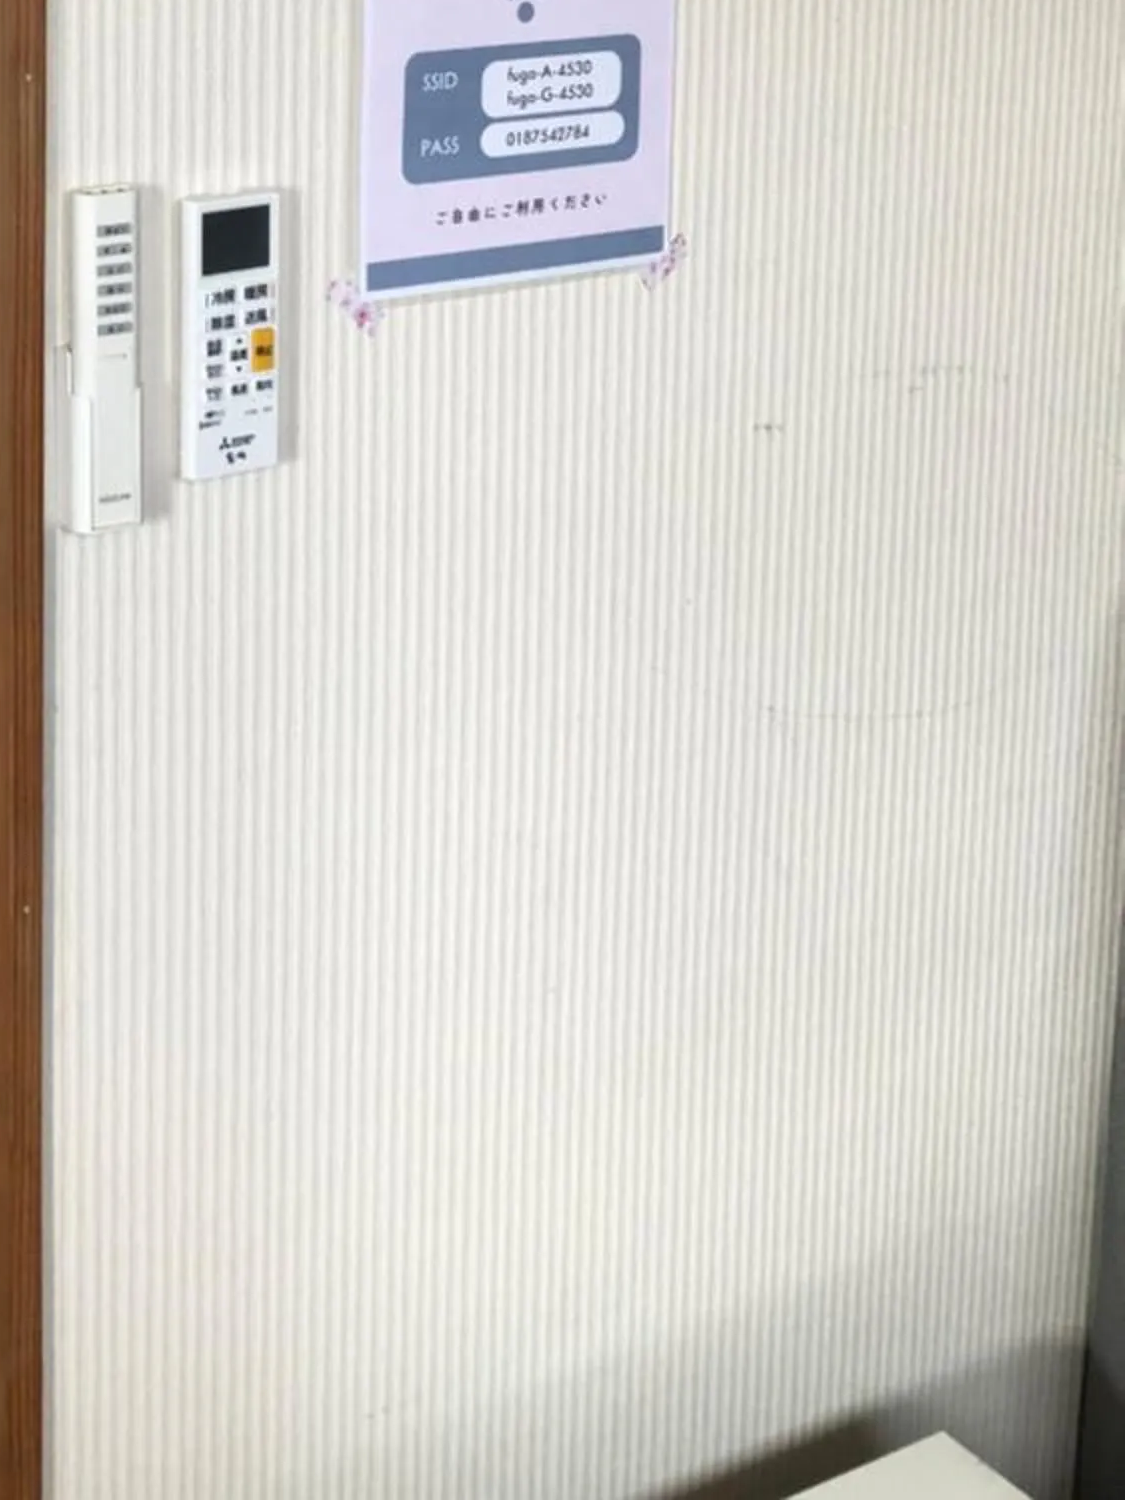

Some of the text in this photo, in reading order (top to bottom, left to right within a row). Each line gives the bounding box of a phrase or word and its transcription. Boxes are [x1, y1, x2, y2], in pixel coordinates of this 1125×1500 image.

[422, 71, 459, 91] SSID
[420, 135, 460, 156] PASS
[436, 192, 607, 225] ご自由にご利用ください
